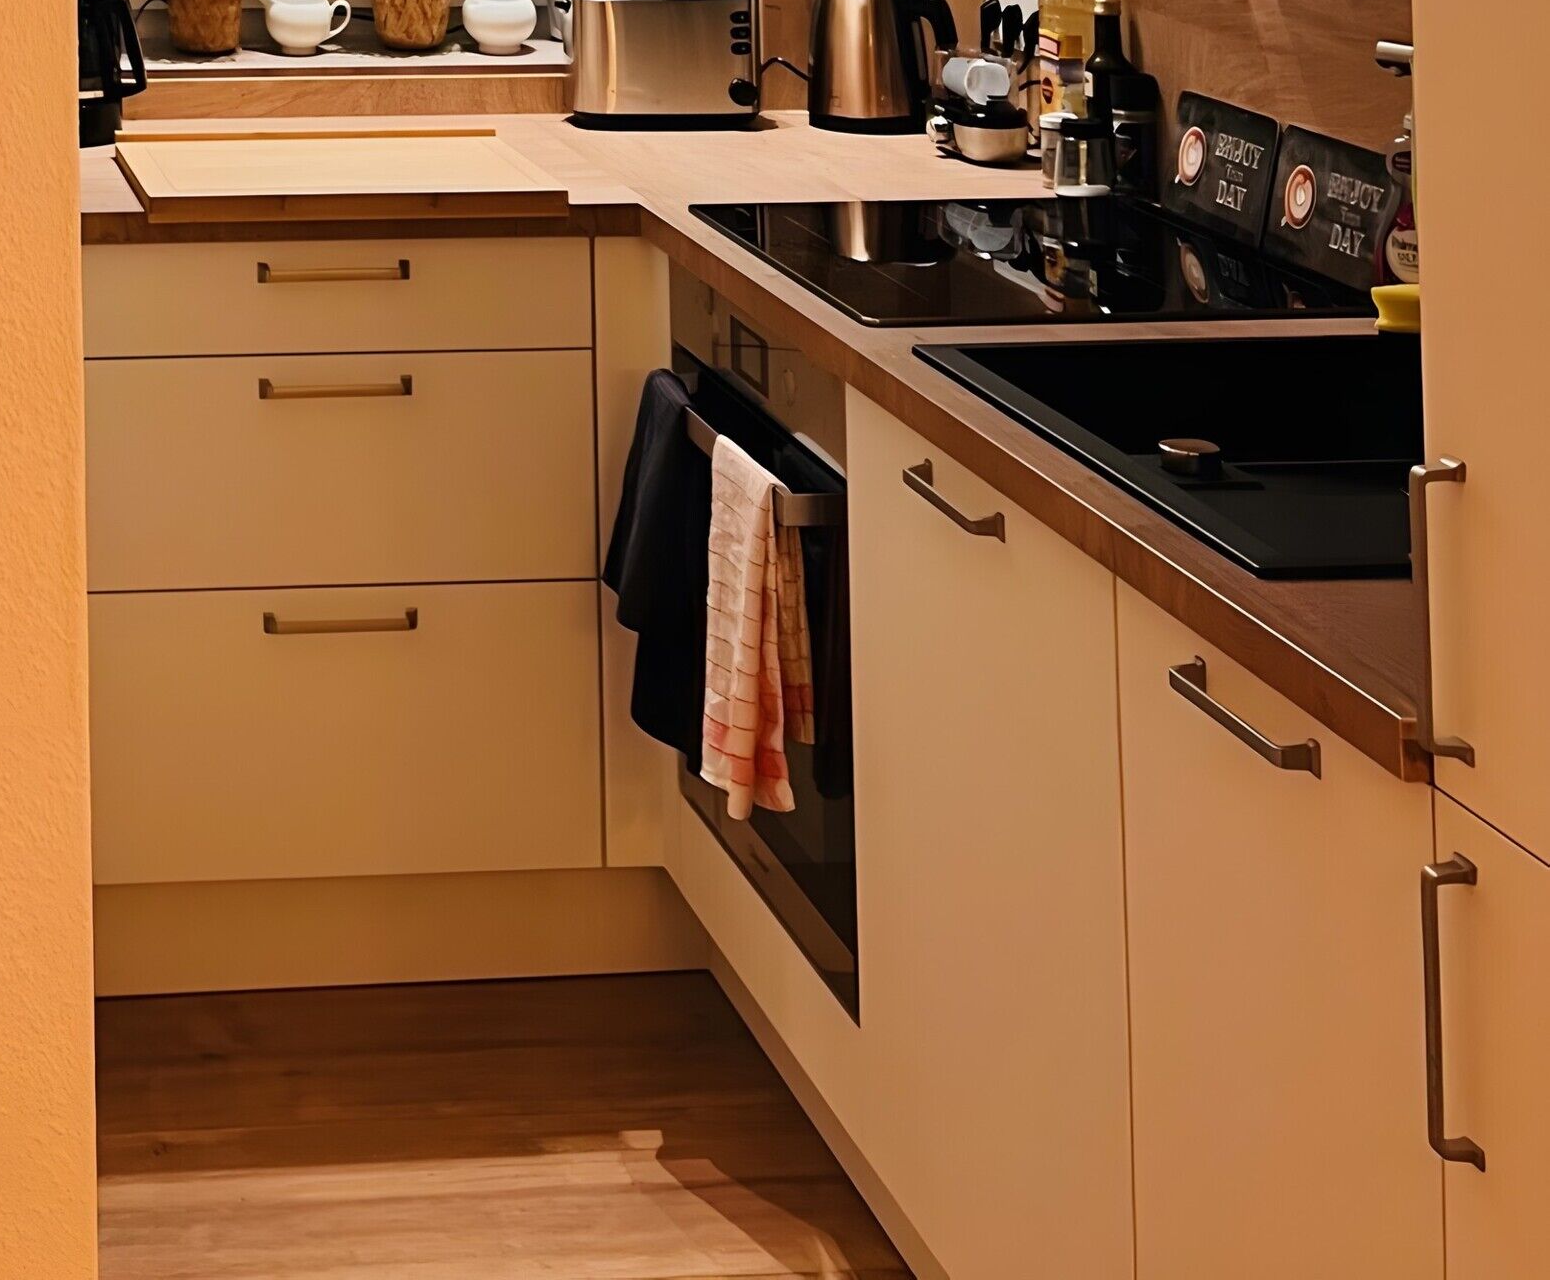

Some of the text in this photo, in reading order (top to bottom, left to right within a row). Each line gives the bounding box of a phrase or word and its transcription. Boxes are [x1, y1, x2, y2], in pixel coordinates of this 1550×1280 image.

[1215, 133, 1265, 169] ENJOY
[1215, 179, 1247, 211] DAY
[1327, 172, 1385, 213] ENJOY
[1328, 223, 1365, 258] DAY
